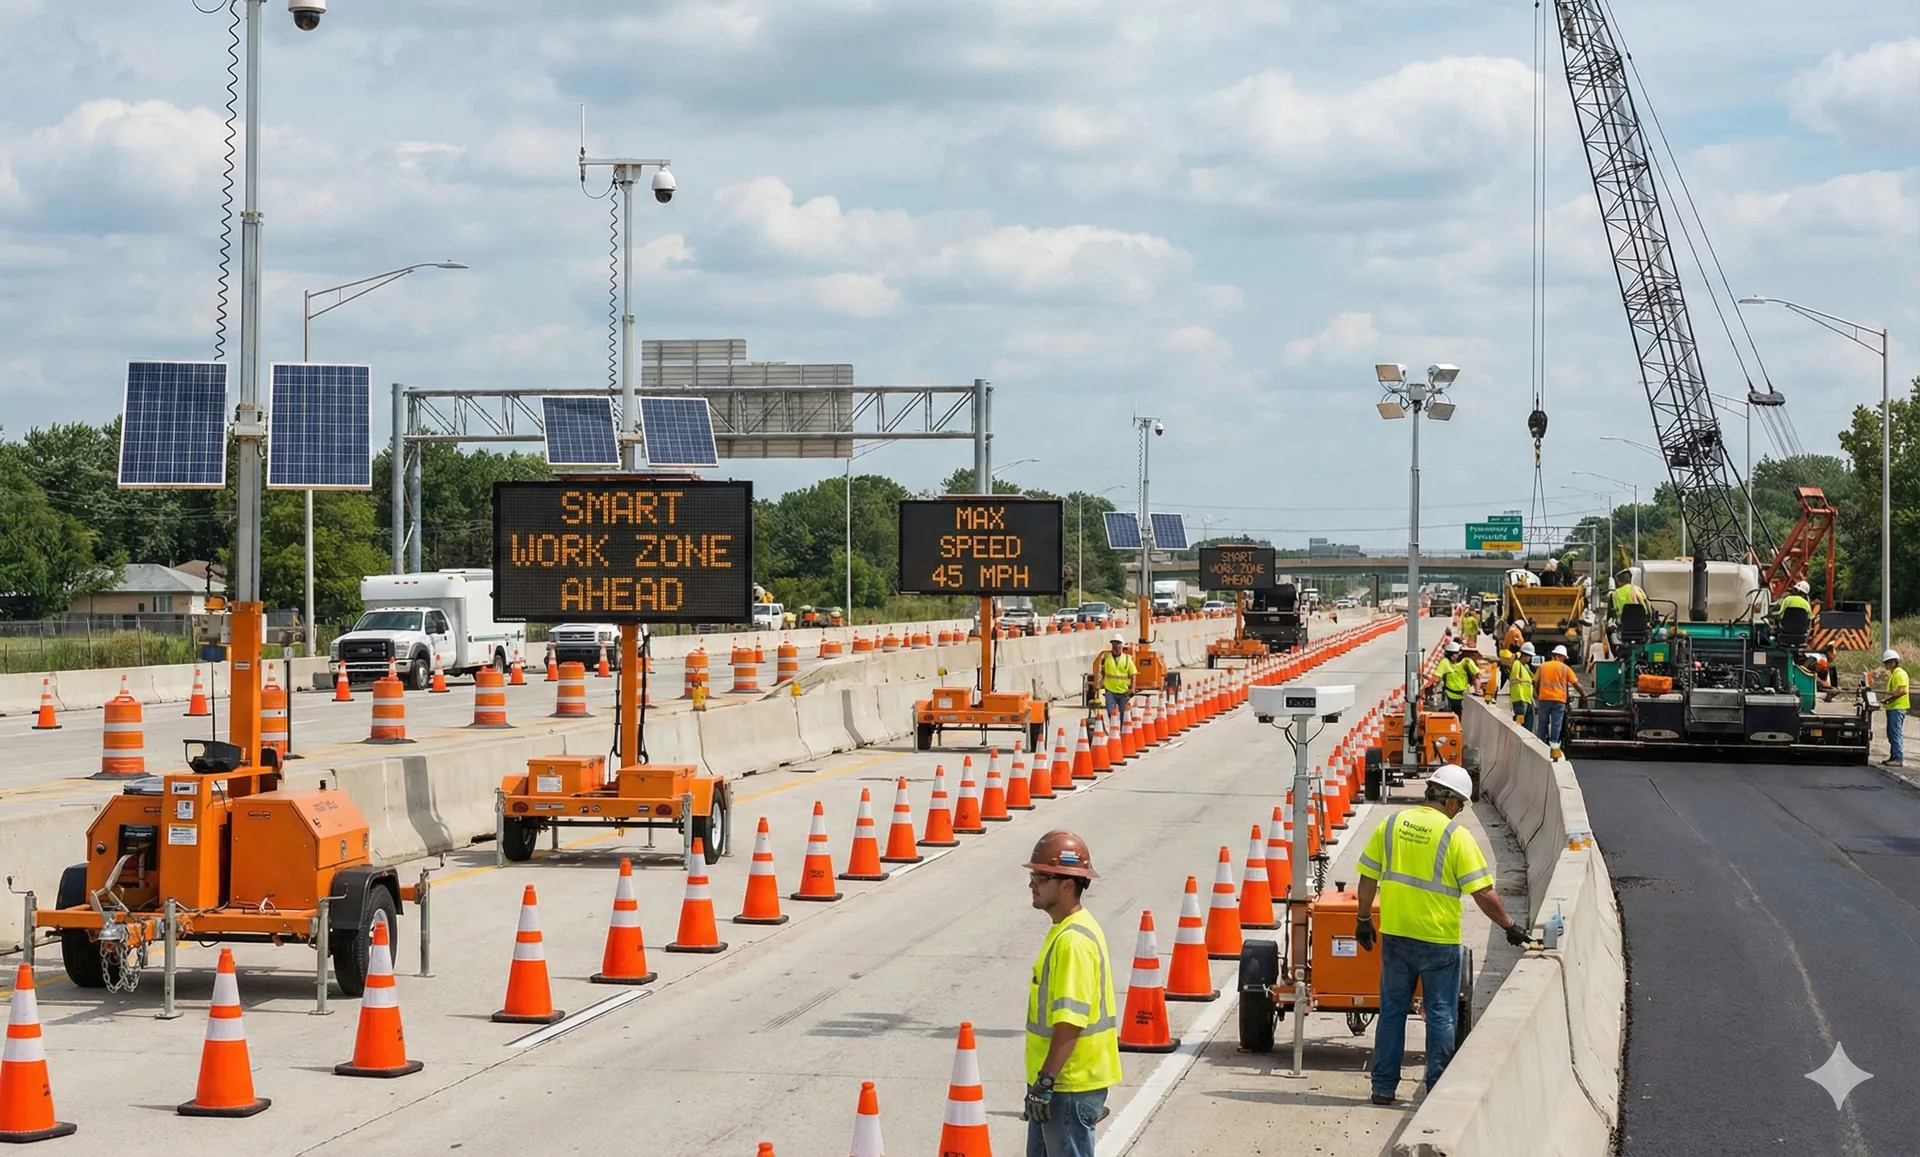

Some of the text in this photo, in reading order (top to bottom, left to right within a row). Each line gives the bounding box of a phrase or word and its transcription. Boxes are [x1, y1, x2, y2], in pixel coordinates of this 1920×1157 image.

[561, 491, 683, 524] SMART
[956, 507, 1005, 530] MAX
[511, 534, 732, 567] WORK ZONE
[940, 535, 1021, 558] SPEED
[932, 564, 1029, 588] 45 MPH
[561, 577, 683, 611] AHEAD
